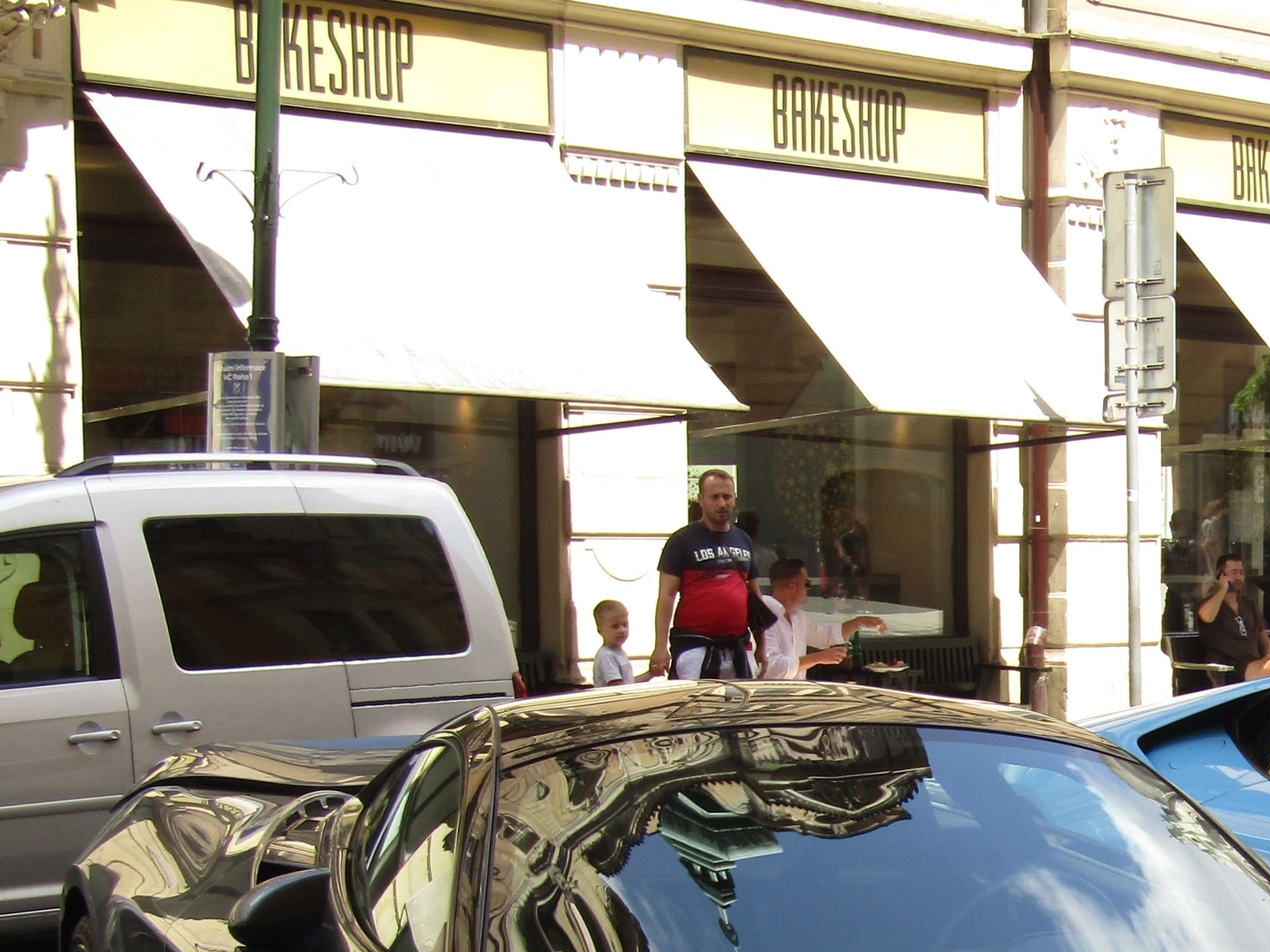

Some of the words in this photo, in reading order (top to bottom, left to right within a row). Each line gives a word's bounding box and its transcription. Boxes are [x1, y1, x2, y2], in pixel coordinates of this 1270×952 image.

[234, 0, 414, 103] BKESHOP
[773, 74, 906, 164] BAKESHOP
[694, 547, 716, 562] LOS
